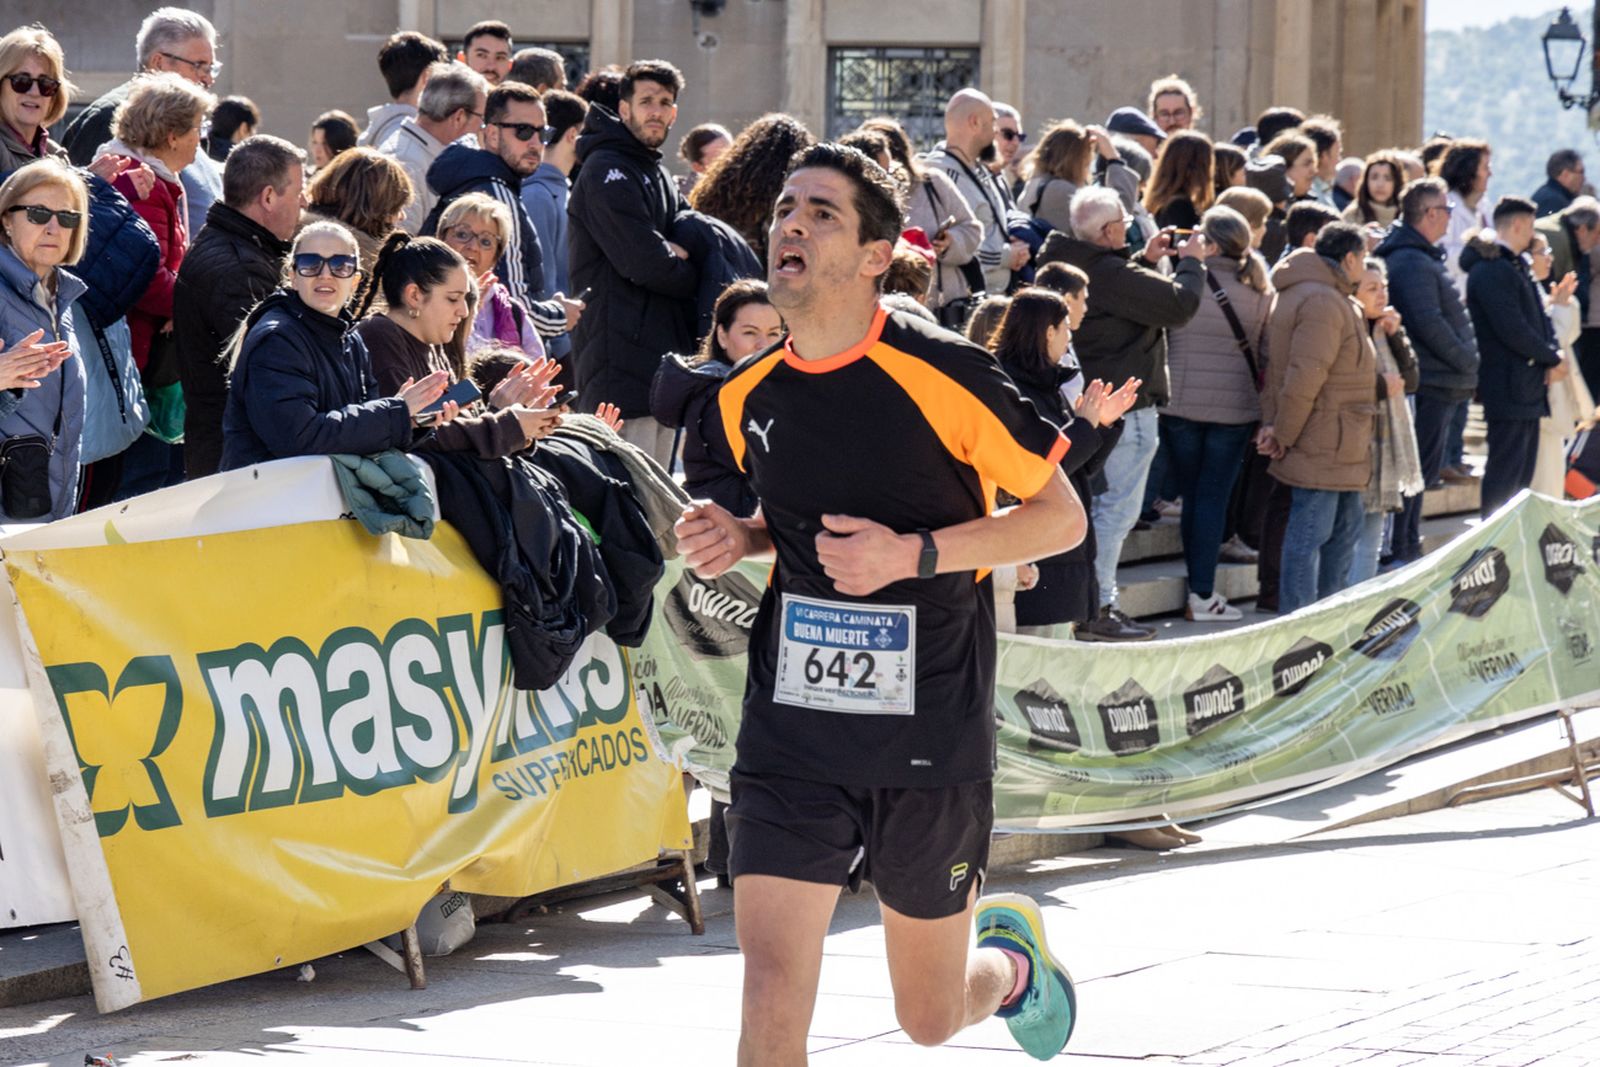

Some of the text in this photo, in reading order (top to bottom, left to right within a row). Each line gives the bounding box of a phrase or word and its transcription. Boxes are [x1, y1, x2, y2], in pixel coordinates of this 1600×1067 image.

[804, 609, 841, 623] CARRERA
[843, 614, 894, 627] CAMINATA
[793, 622, 870, 647] BUENA MUERTE
[804, 647, 876, 689] 642
[1194, 682, 1236, 719] ownat
[1026, 704, 1071, 733] ownat
[1108, 700, 1149, 733] ownat
